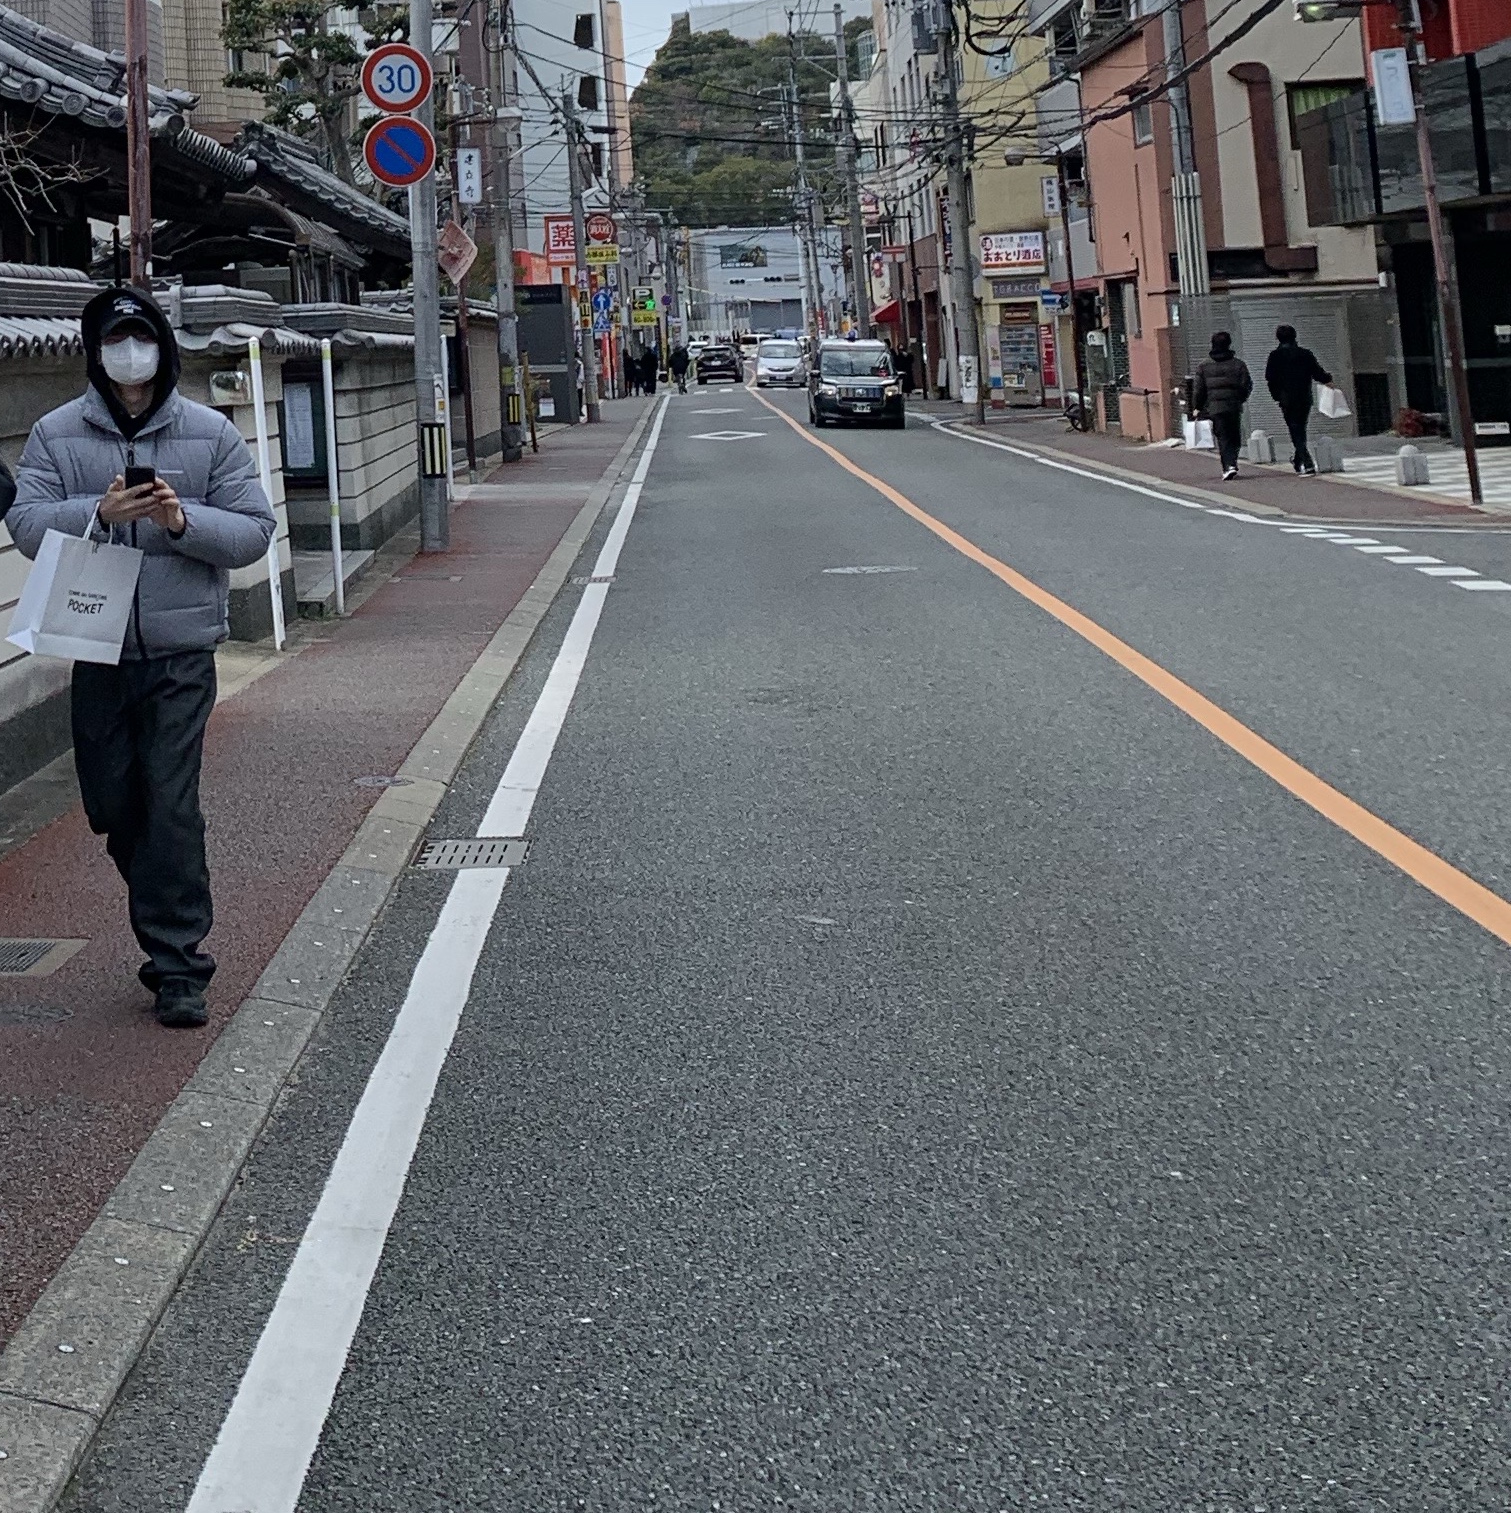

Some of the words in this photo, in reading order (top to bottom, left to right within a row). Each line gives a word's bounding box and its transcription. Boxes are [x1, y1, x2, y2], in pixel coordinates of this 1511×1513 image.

[377, 64, 416, 94] 30
[552, 224, 576, 247] 薬
[983, 249, 1041, 263] おおとり酒店
[67, 598, 104, 615] POCKET
